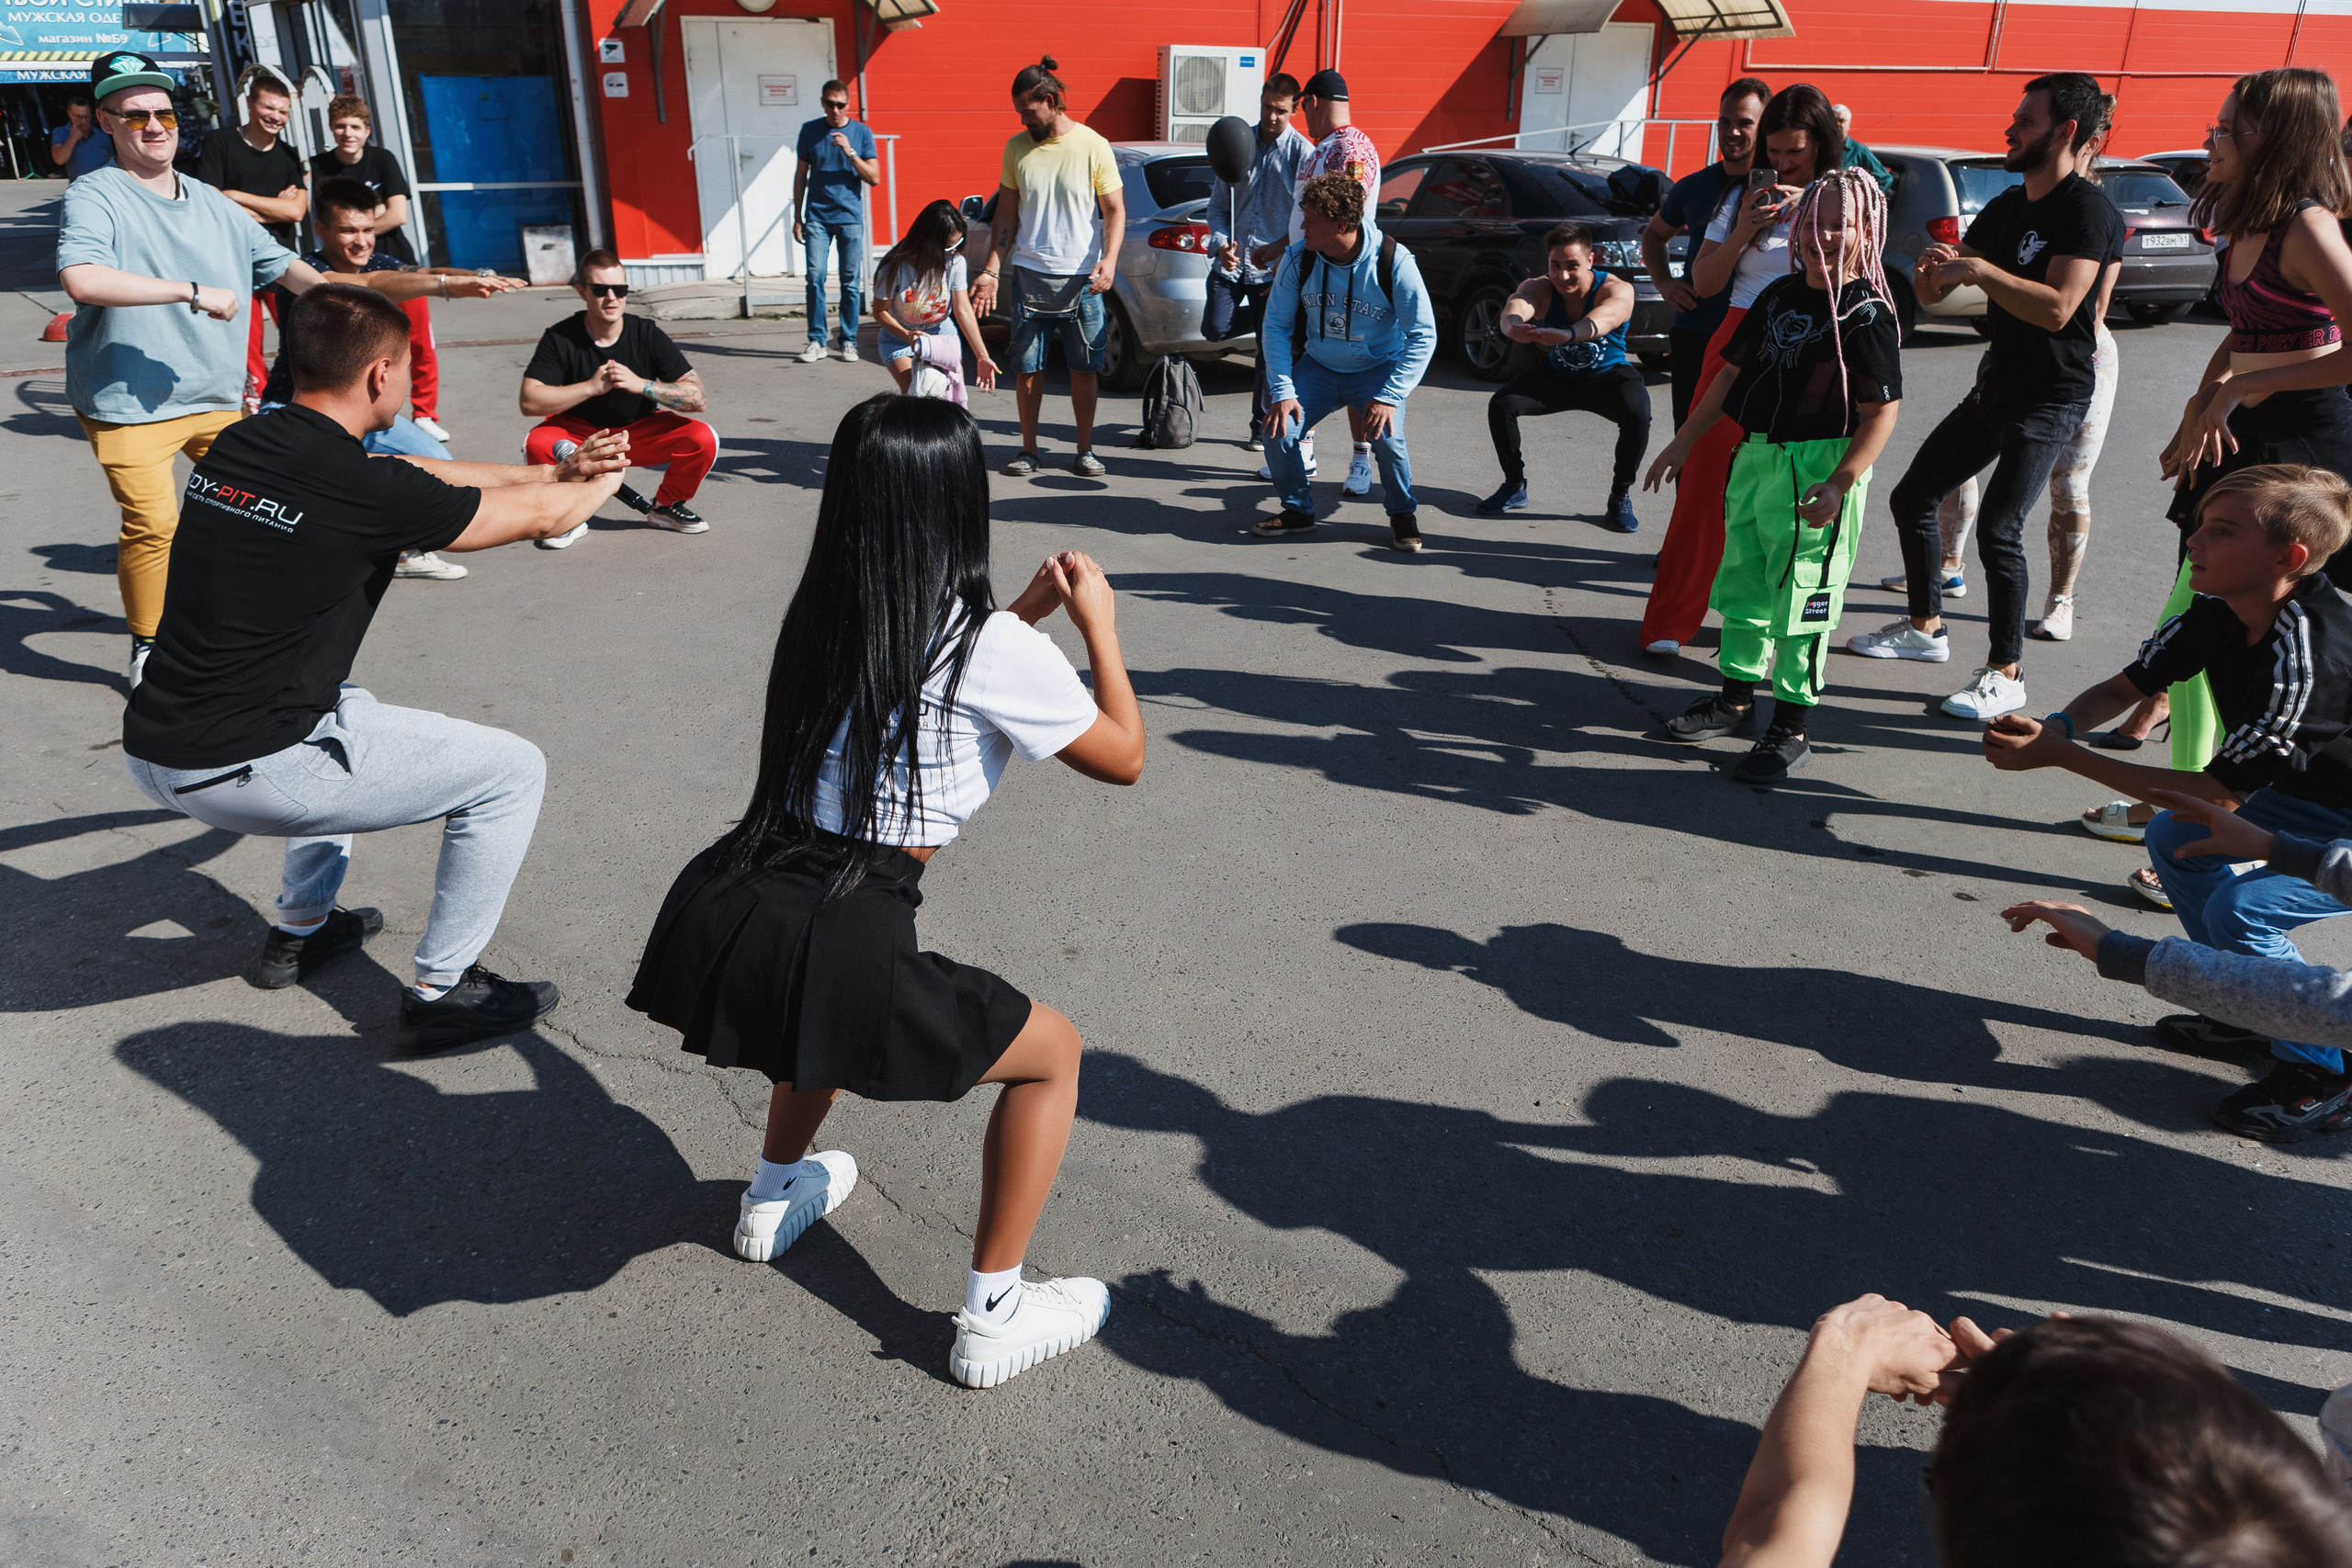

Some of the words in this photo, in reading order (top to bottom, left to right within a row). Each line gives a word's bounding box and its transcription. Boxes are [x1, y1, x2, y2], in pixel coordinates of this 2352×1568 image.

[8, 11, 85, 23] МУЖСКАЯ
[89, 12, 123, 24] ОДЕ
[38, 35, 93, 44] магазин
[17, 70, 87, 81] МУЖСКАЯ
[2256, 328, 2324, 352] POWER
[205, 498, 252, 518] СПОРТИВНОГО
[251, 513, 294, 534] ПИТАНИЯ
